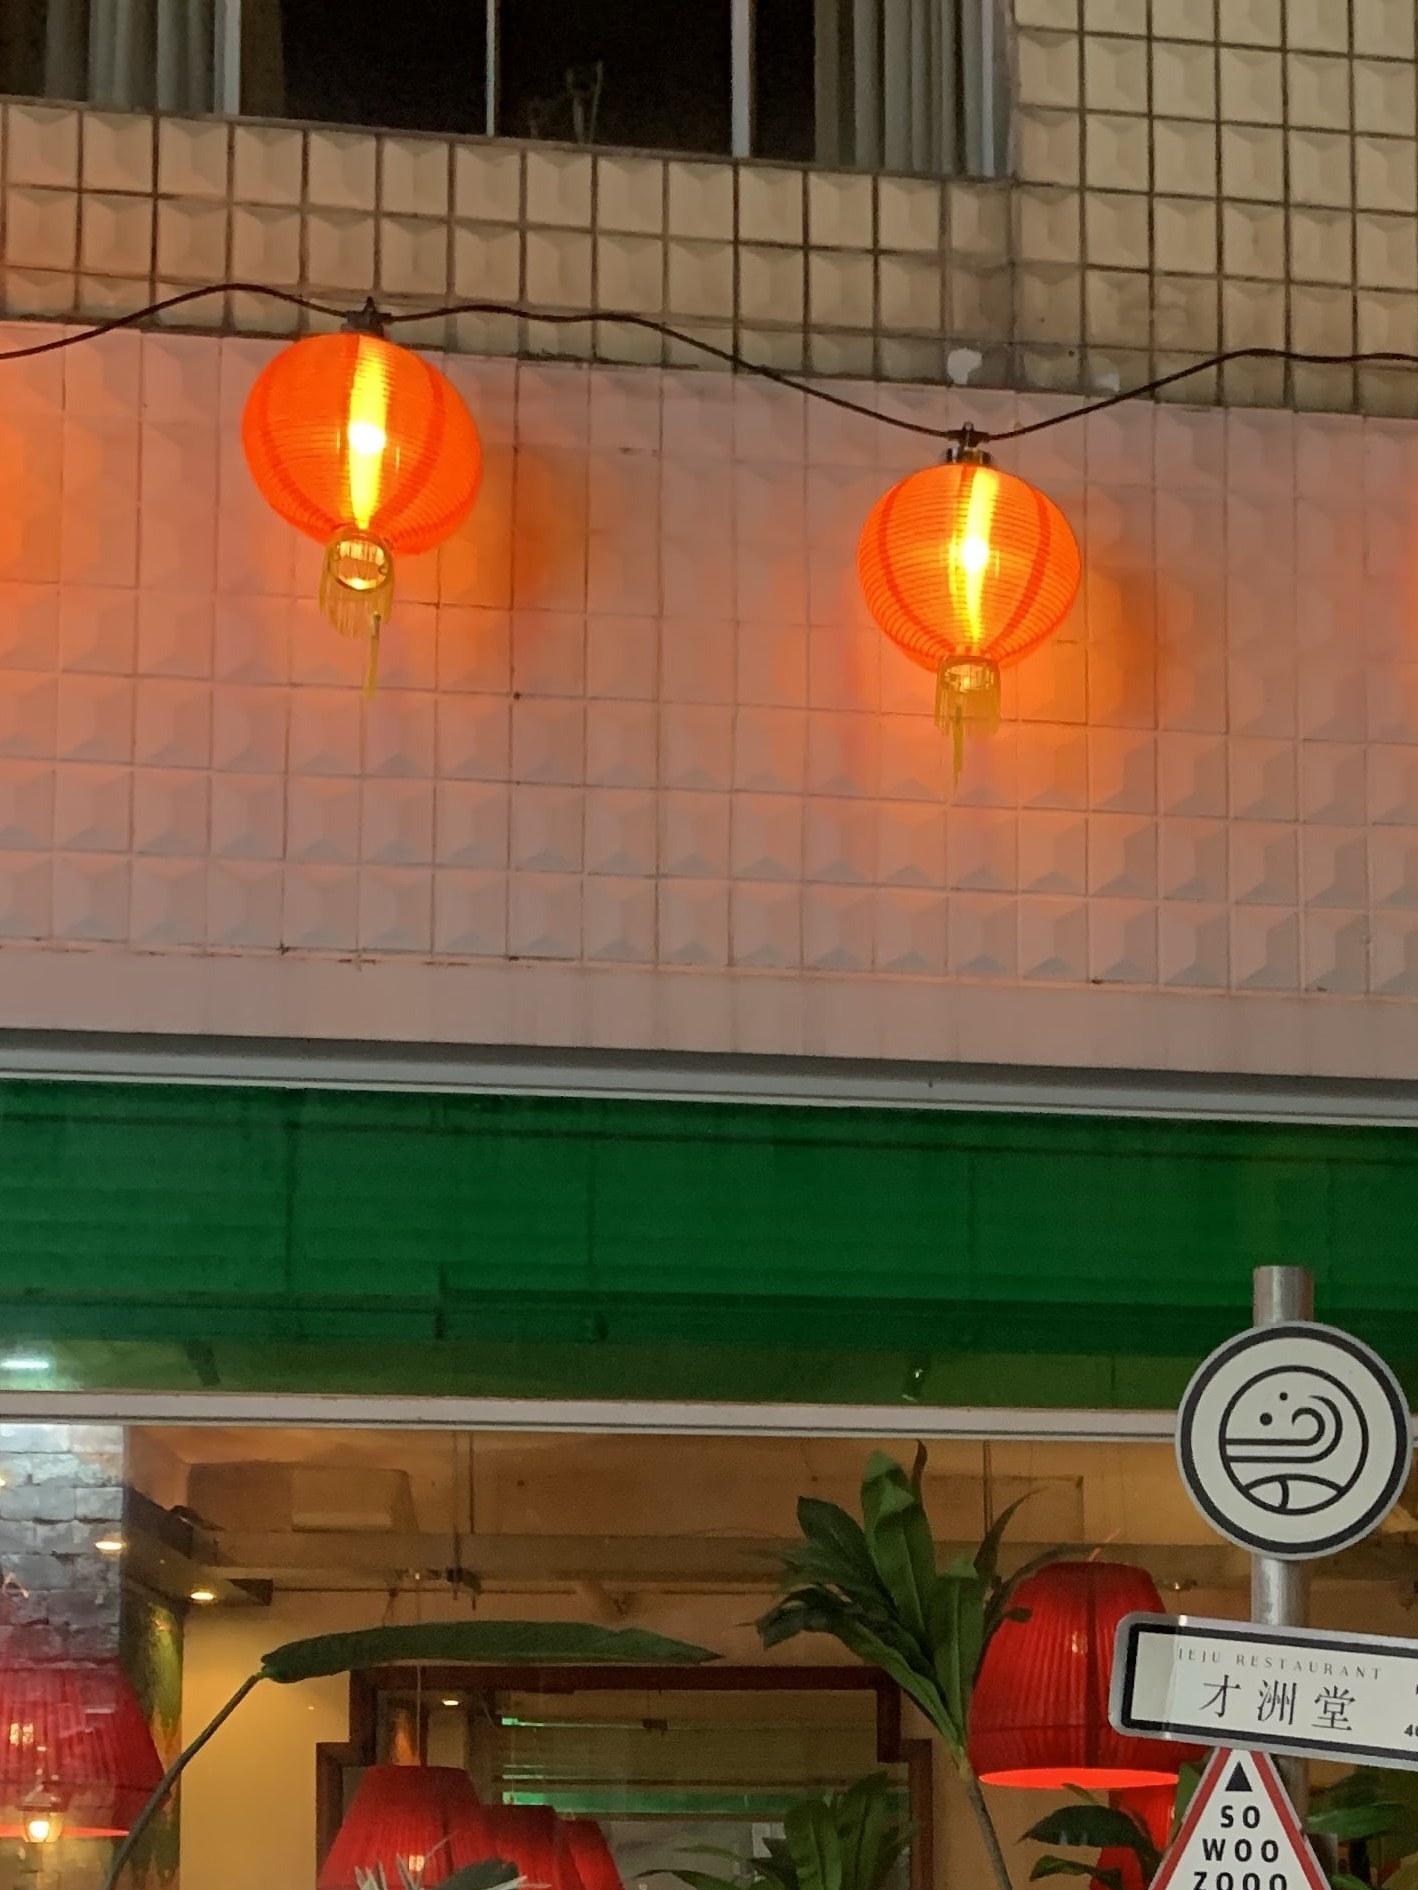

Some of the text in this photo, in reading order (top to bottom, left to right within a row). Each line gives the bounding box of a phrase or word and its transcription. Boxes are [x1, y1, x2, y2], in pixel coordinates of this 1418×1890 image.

[1236, 1654, 1382, 1680] RESTAURANT
[1199, 1674, 1356, 1732] 才洲堂
[1219, 1804, 1261, 1830] SO
[1202, 1838, 1280, 1863] WOO
